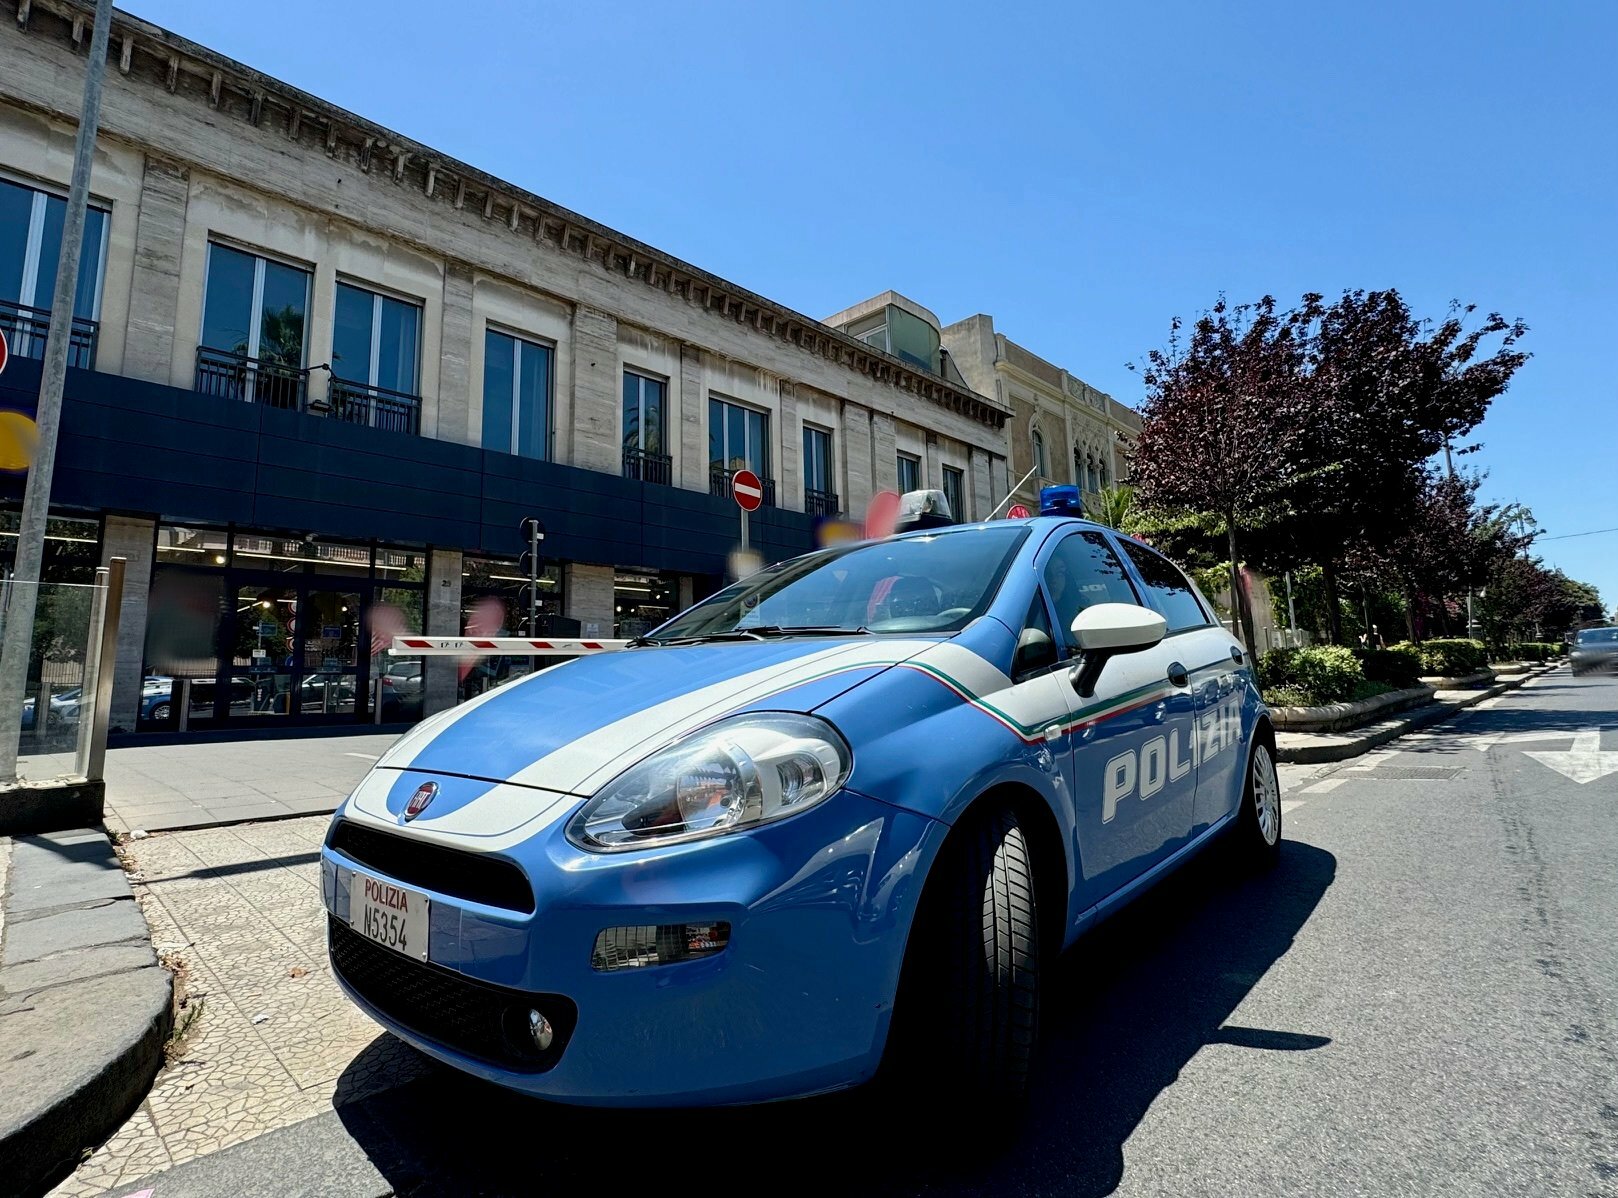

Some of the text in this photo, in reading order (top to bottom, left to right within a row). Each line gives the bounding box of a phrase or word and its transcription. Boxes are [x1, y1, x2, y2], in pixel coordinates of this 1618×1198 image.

[1102, 698, 1242, 825] POLIZIA
[365, 879, 408, 913] POLIZIA
[364, 904, 407, 951] N5354
